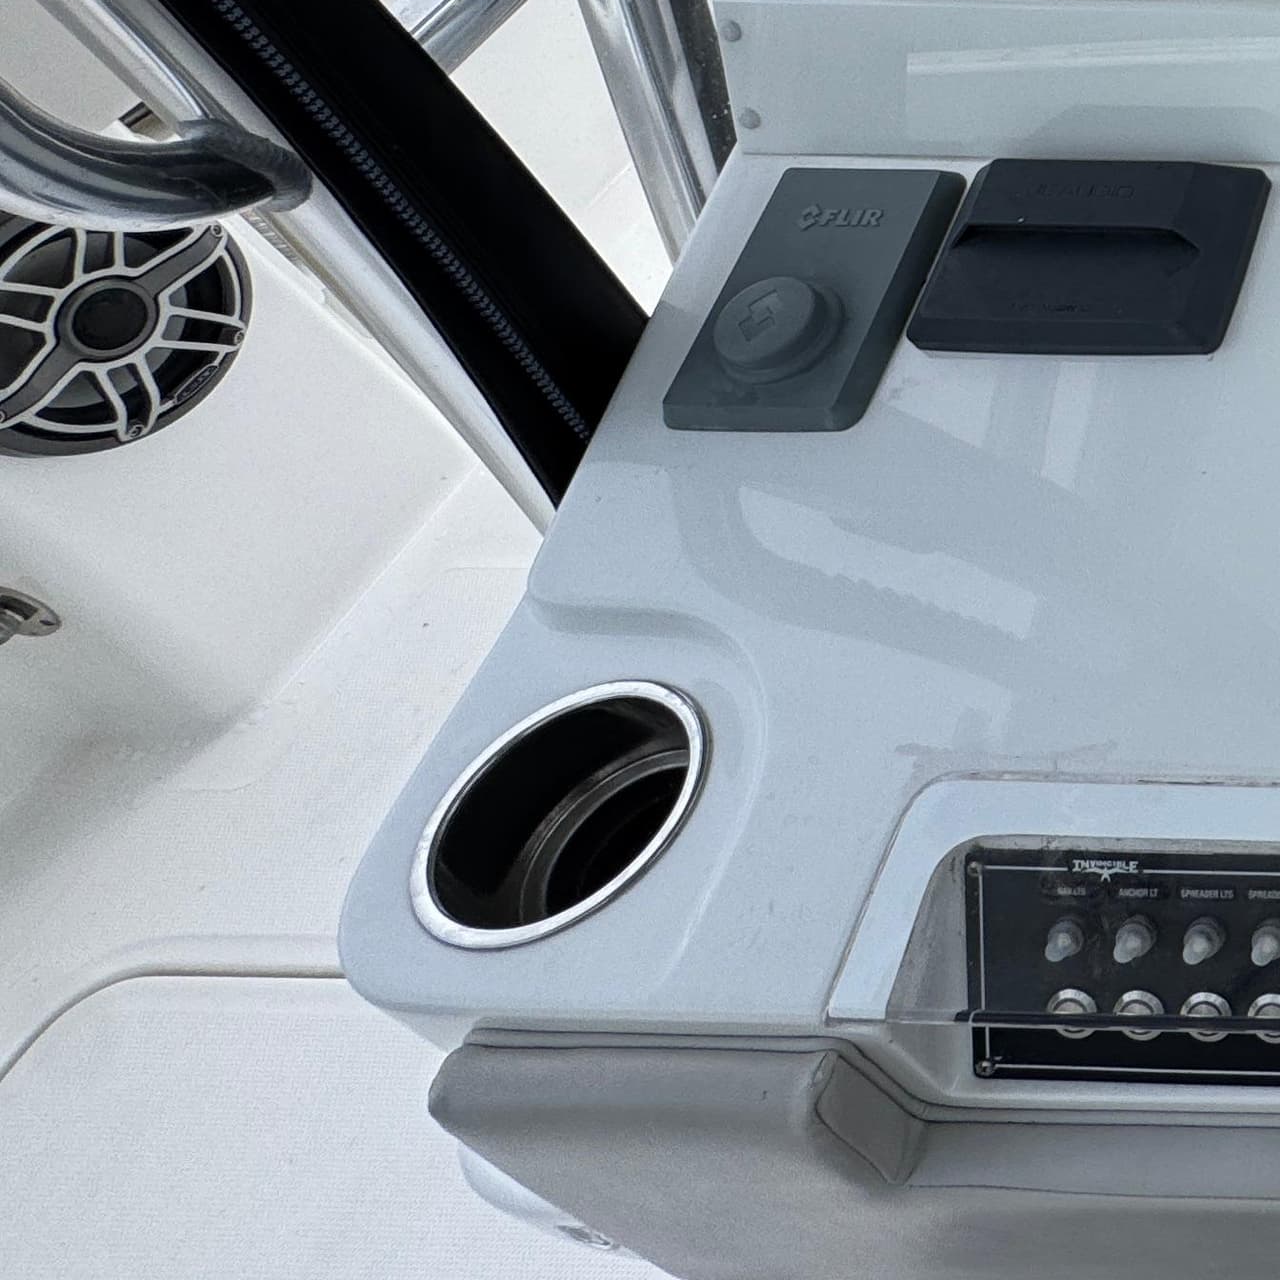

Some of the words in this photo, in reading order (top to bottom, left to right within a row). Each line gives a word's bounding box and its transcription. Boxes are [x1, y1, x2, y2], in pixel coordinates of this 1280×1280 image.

[819, 207, 885, 228] FLIR
[1072, 860, 1139, 874] INVINCIBLE
[1180, 889, 1219, 899] SPREADER
[1220, 889, 1234, 899] LTS
